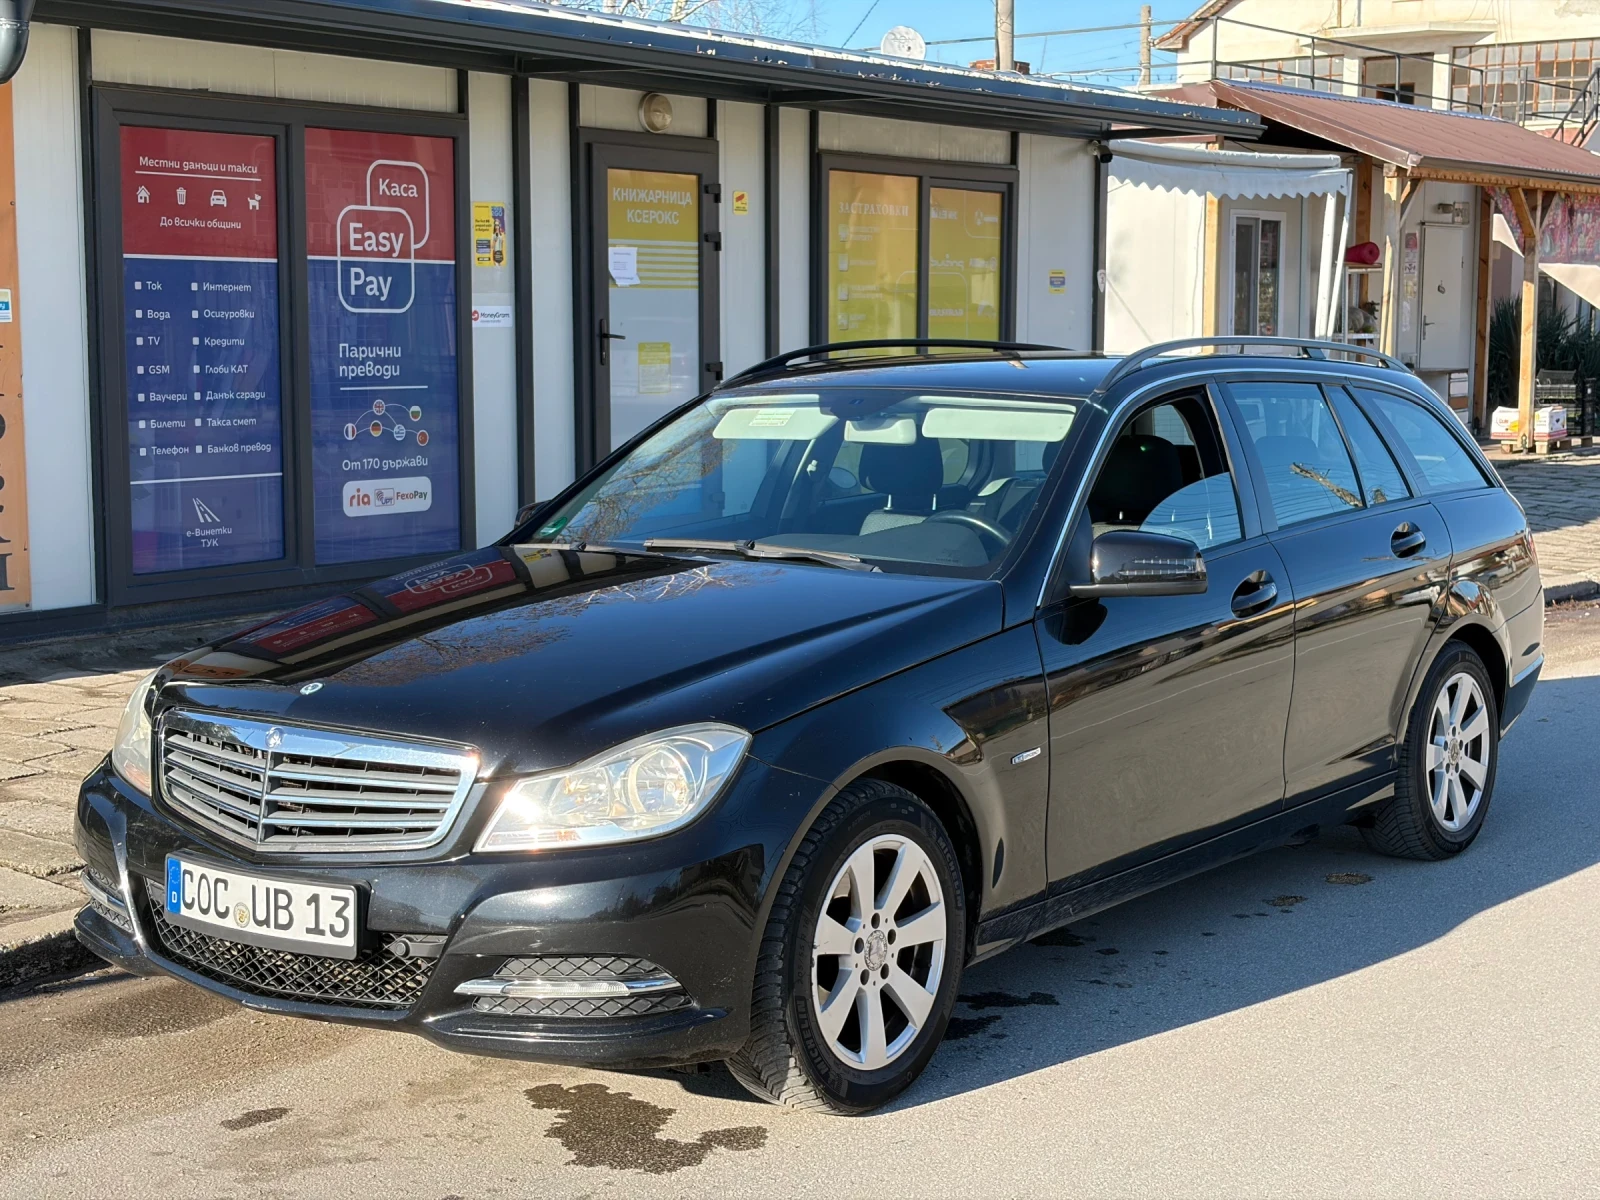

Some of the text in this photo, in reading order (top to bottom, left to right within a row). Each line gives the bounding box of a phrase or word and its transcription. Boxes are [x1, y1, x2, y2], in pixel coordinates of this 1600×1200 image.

[140, 156, 180, 168] Местни
[182, 160, 218, 172] данъци
[228, 163, 258, 174] такси
[379, 178, 418, 198] Каса
[612, 187, 692, 207] КНИЖАРНИЦА
[838, 202, 909, 216] ЗАСТРАХОВКИ
[160, 216, 242, 229] До всички общини
[626, 209, 680, 224] КСЕРОКС
[350, 222, 404, 258] Easy
[146, 281, 162, 290] Ток
[202, 282, 252, 292] Интернет
[350, 268, 392, 302] Pay
[147, 310, 170, 320] Вода
[204, 309, 254, 320] Осигуровки
[148, 336, 160, 346] TV
[204, 337, 244, 347] Кредити
[339, 344, 401, 360] Парични
[148, 366, 170, 374] GSM
[205, 364, 248, 374] Глоби КАТ
[339, 362, 400, 380] преводи
[150, 392, 188, 402] Ваучери
[206, 390, 266, 401] Данък сгради
[150, 420, 186, 428] Билети
[206, 417, 257, 427] Такса смет
[151, 445, 189, 457] Телефон
[208, 442, 272, 454] Банков превод
[342, 456, 428, 470] От 170 държави
[349, 488, 370, 507] ria
[396, 490, 428, 501] FexoPay
[186, 526, 232, 538] е-Винетки
[201, 538, 219, 548] ТУК
[937, 836, 962, 907] MICHELIN
[172, 891, 177, 903] D
[182, 868, 350, 938] COC UB 13
[796, 999, 830, 1075] MICHELIN
